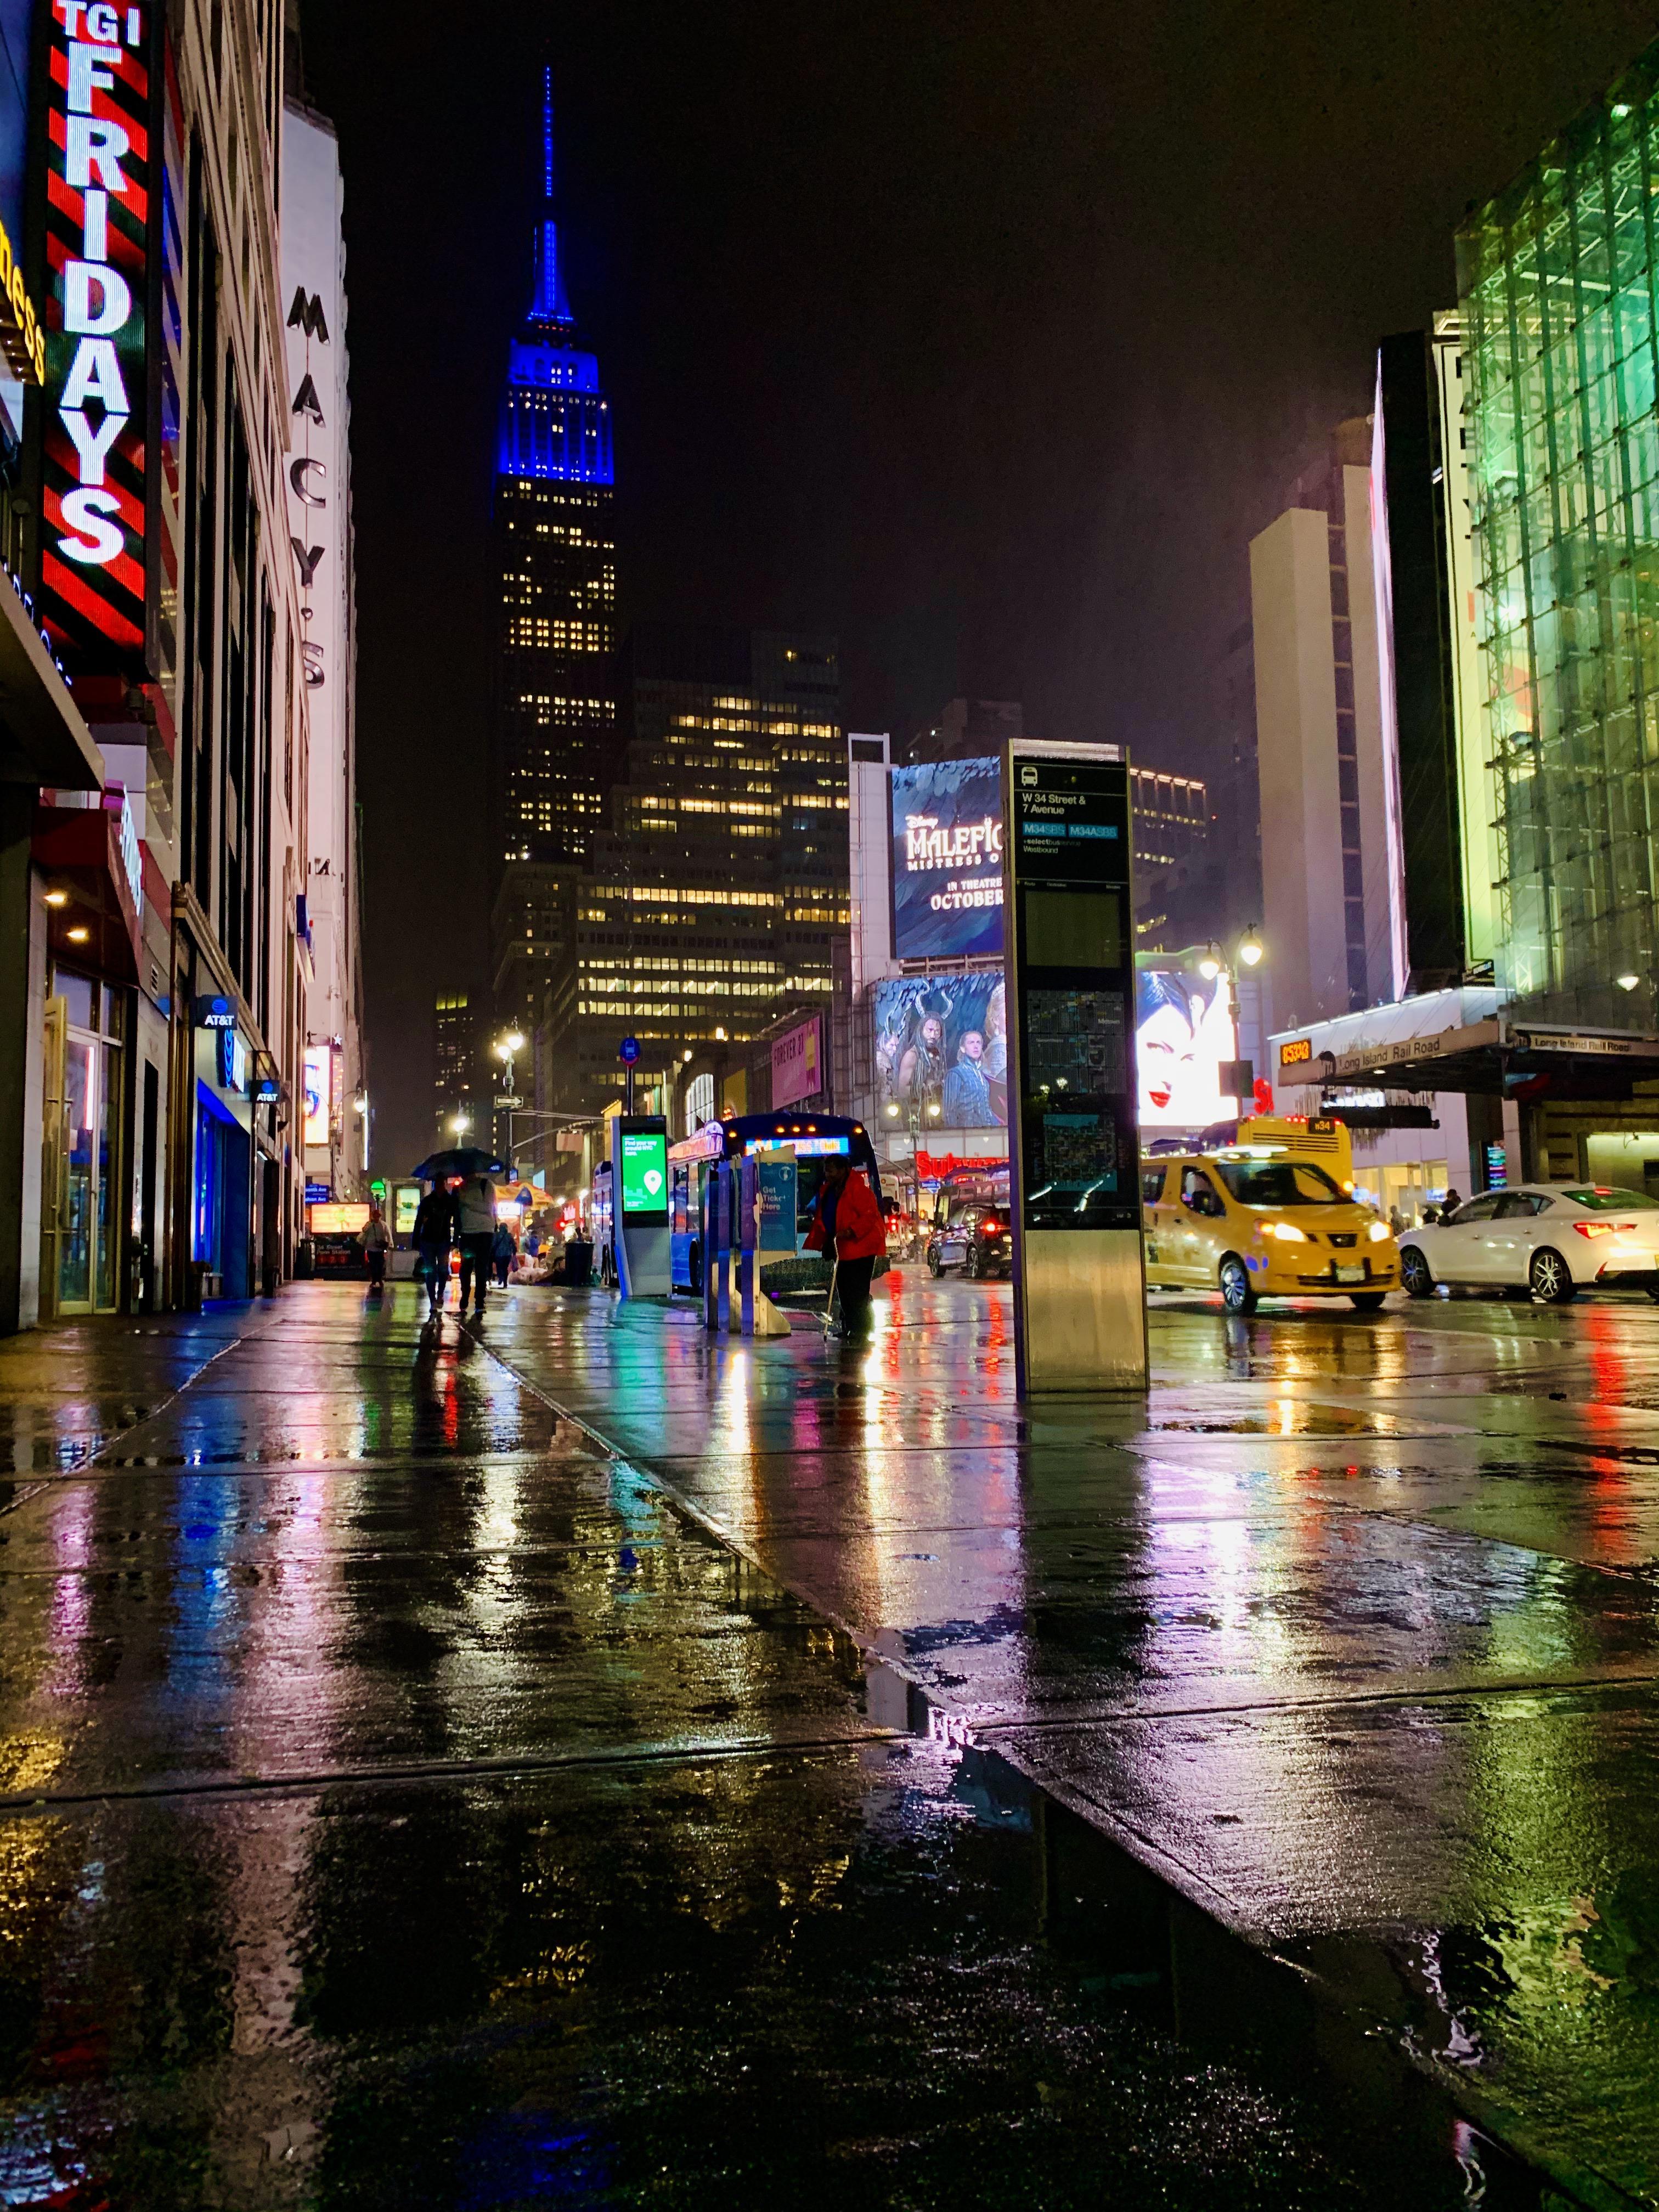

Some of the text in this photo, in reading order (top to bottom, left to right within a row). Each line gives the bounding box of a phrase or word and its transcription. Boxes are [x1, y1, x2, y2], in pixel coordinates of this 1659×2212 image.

[57, 0, 140, 46] TGI
[57, 41, 131, 564] FRIDAYS
[1022, 793, 1086, 805] W 34 Street &
[1023, 804, 1065, 815] 7 Avenue
[1023, 845, 1058, 854] Westbound
[907, 854, 982, 871] MISTRESS
[947, 882, 957, 891] IN
[930, 889, 1004, 911] OCTOBER
[205, 1014, 234, 1026] AT&T
[774, 1033, 804, 1068] FOREVER 21
[1339, 1038, 1440, 1070] Long Island Rail Road
[257, 1093, 278, 1101] AT&T
[763, 1186, 776, 1194] Get
